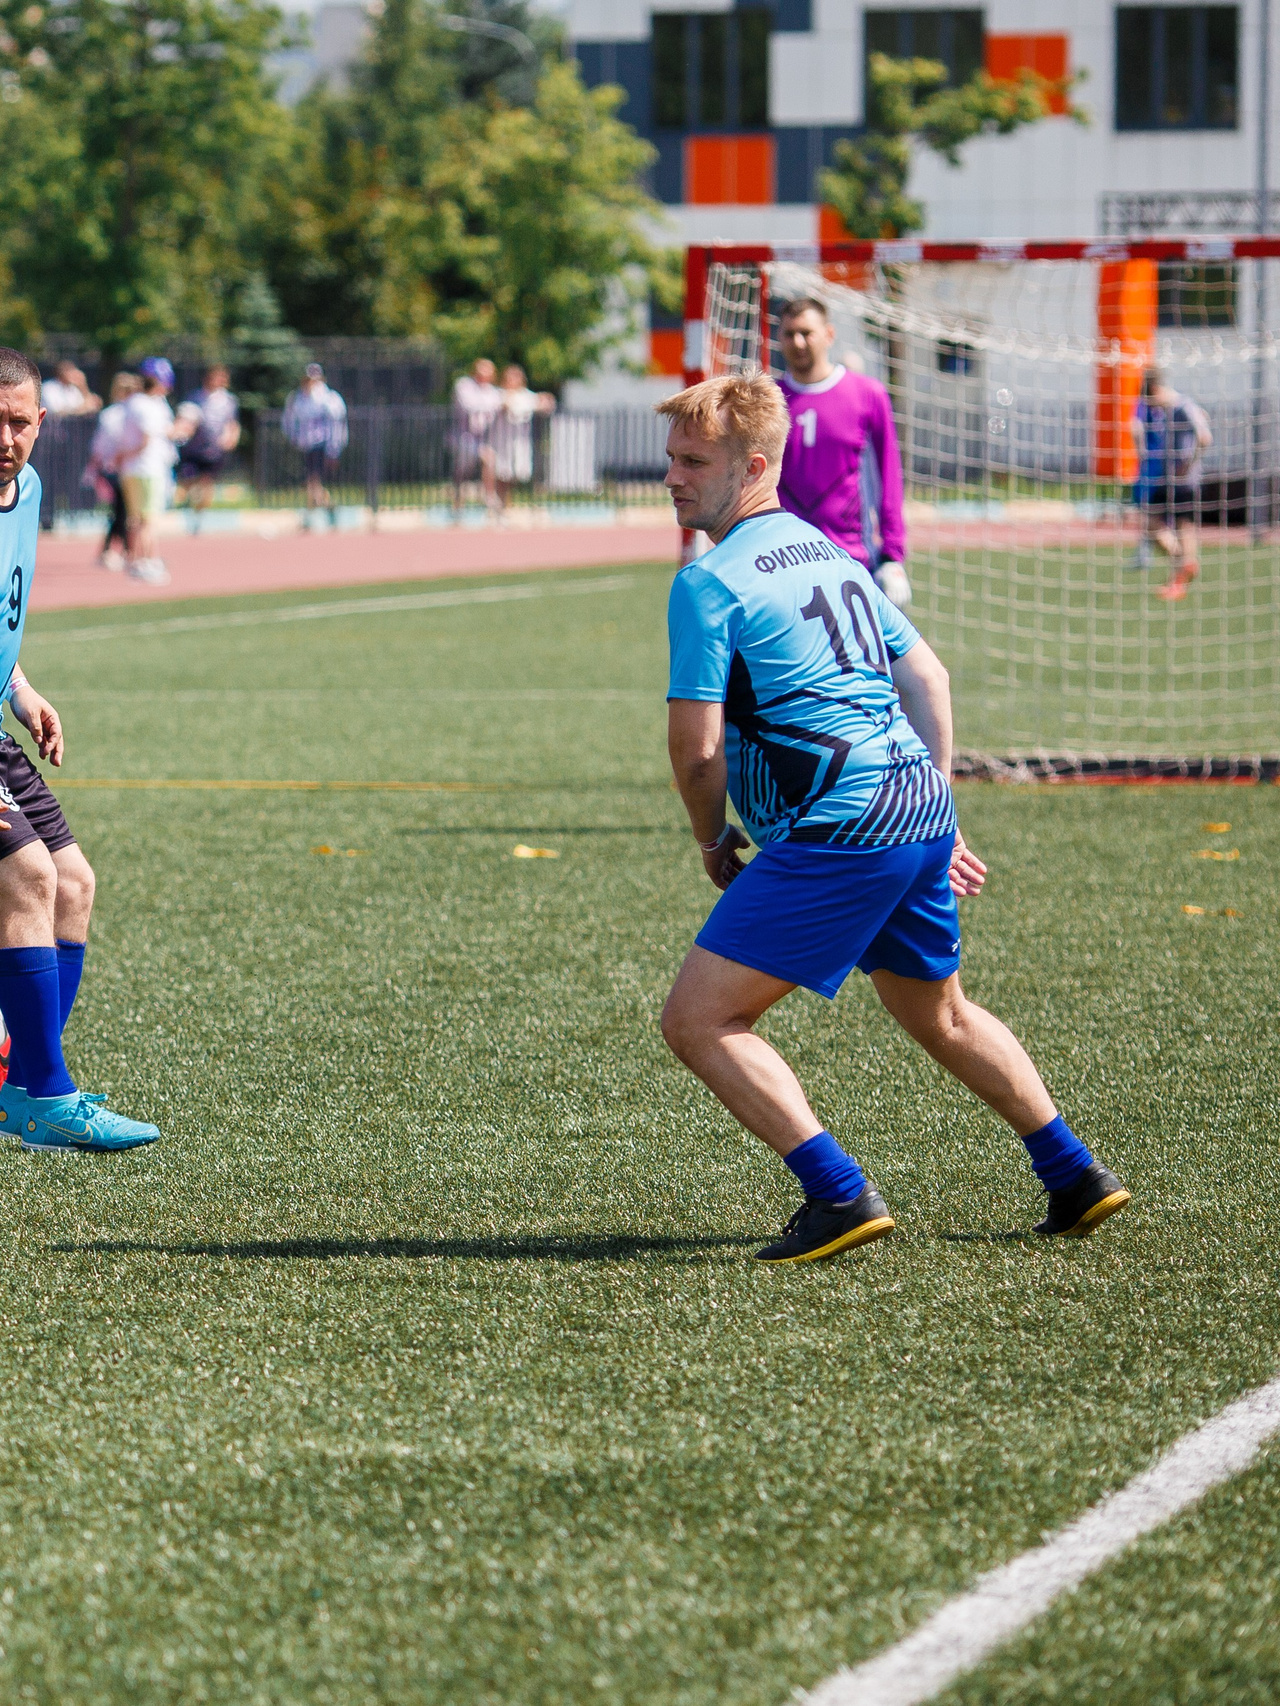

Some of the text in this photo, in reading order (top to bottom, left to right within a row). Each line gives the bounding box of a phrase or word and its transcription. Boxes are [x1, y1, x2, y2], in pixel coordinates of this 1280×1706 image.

[796, 408, 817, 447] 1
[754, 541, 836, 574] ФИЛИАЛ
[8, 565, 22, 631] 9
[800, 580, 888, 676] 10
